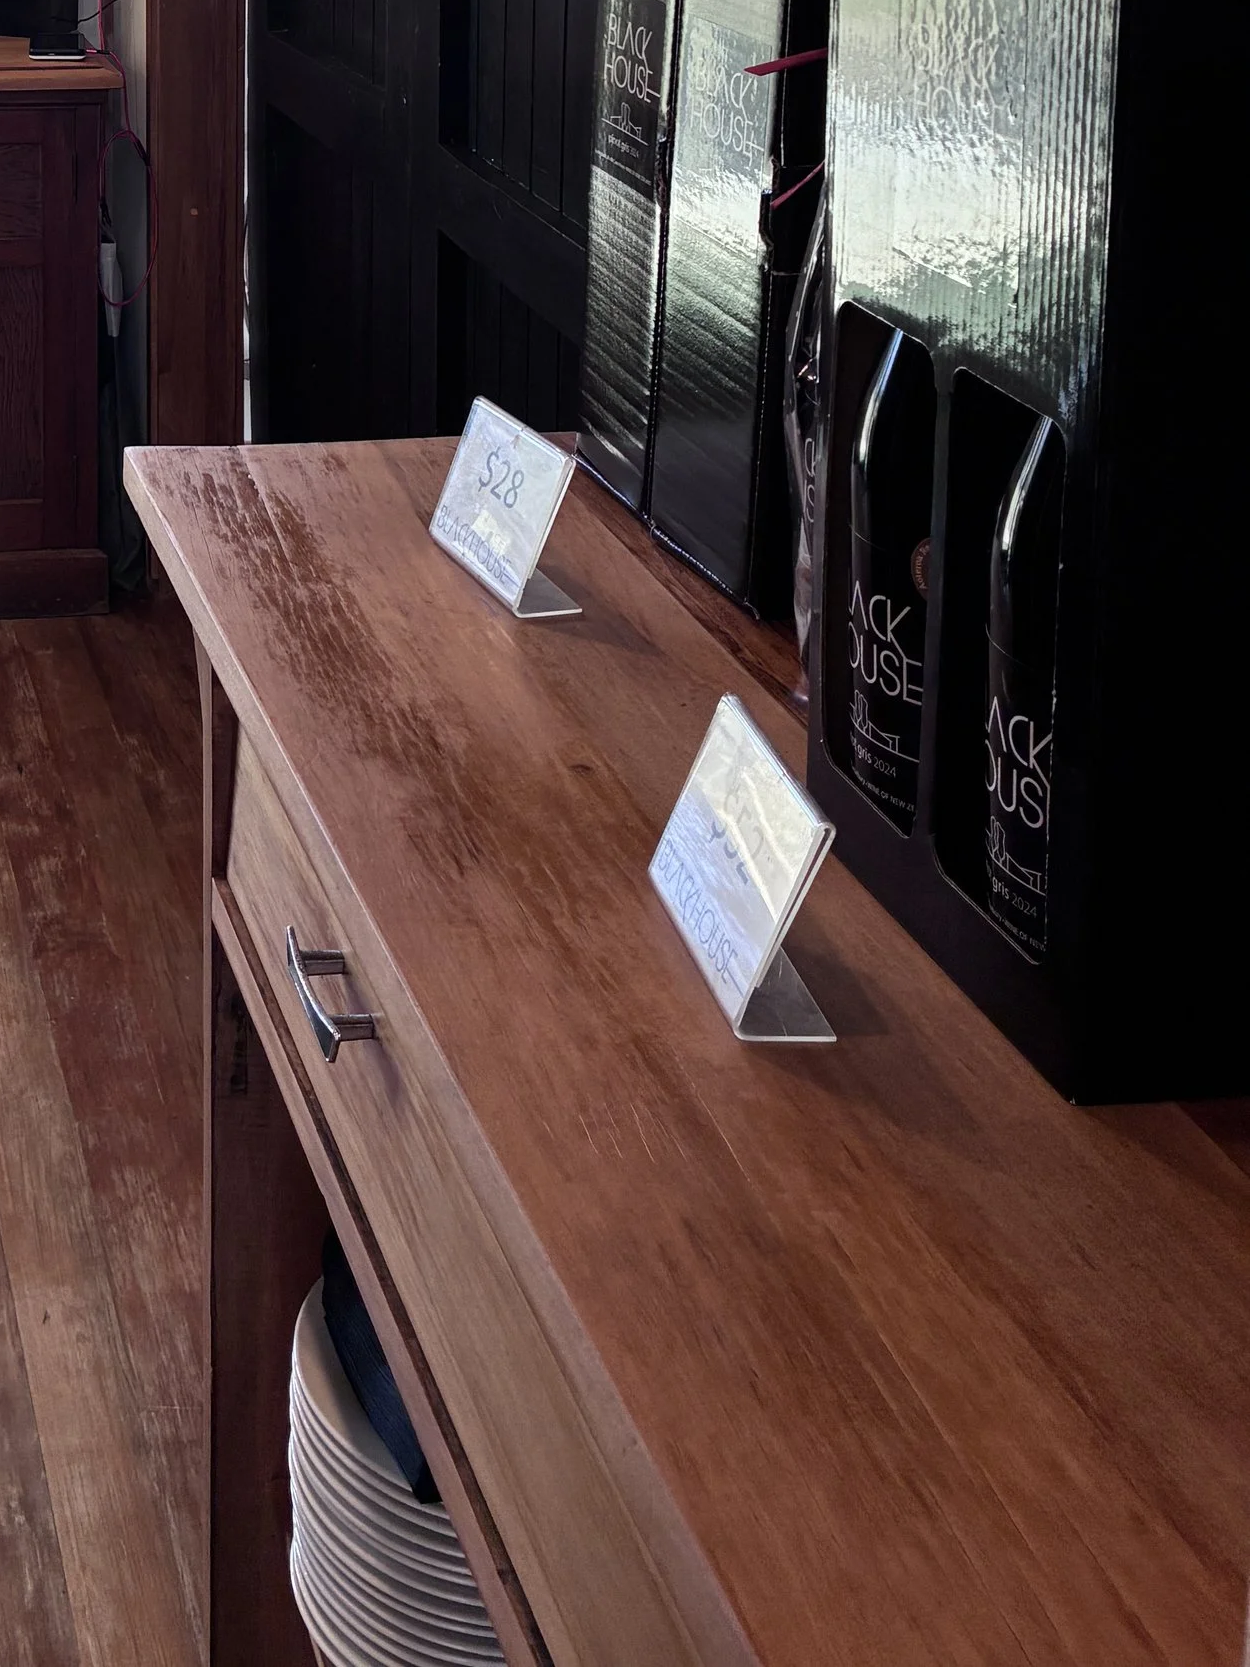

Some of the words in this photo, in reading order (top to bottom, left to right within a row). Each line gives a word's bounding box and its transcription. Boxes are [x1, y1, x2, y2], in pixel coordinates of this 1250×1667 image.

[607, 13, 653, 60] BLACK
[604, 50, 661, 104] HOUSE
[694, 56, 753, 109] BLACK
[690, 101, 764, 156] HOUSE
[478, 447, 525, 509] $28
[437, 504, 519, 587] BLACKHOUSE
[849, 580, 911, 648] ACK
[857, 744, 872, 764] gris
[873, 757, 897, 779] 2024
[985, 696, 1052, 774] ACK
[985, 739, 1050, 829] OUS
[992, 876, 1010, 900] gris
[1011, 892, 1037, 919] 2024
